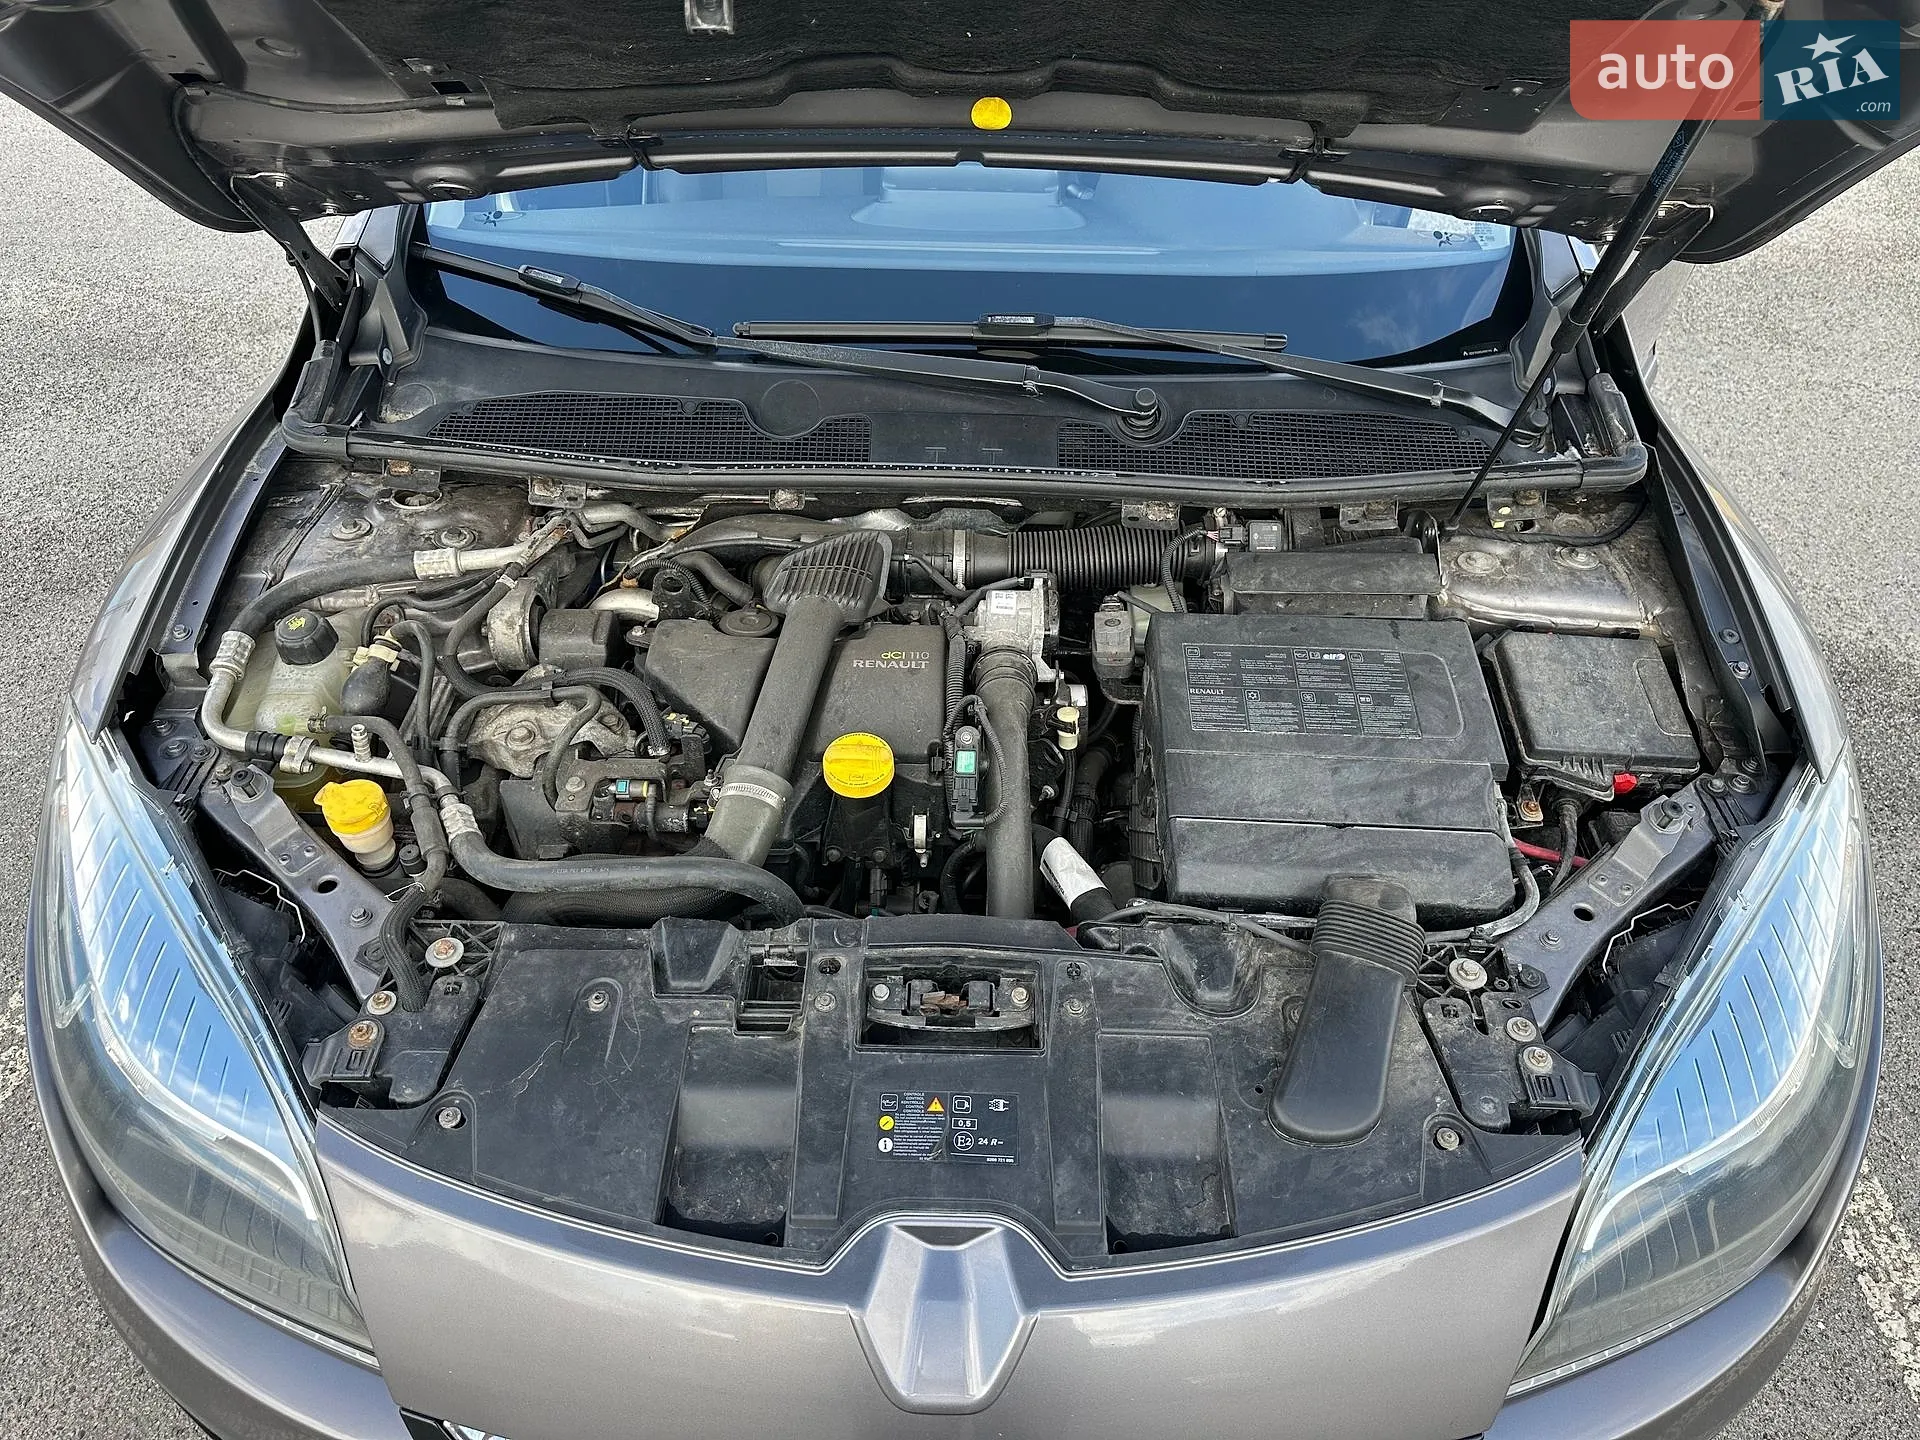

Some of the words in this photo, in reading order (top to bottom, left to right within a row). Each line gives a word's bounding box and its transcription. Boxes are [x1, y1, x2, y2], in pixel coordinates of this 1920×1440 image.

[909, 651, 930, 660] 110
[853, 659, 930, 669] RENAULT
[958, 1119, 971, 1128] 0,5
[957, 1135, 972, 1147] E2
[977, 1137, 989, 1146] 24
